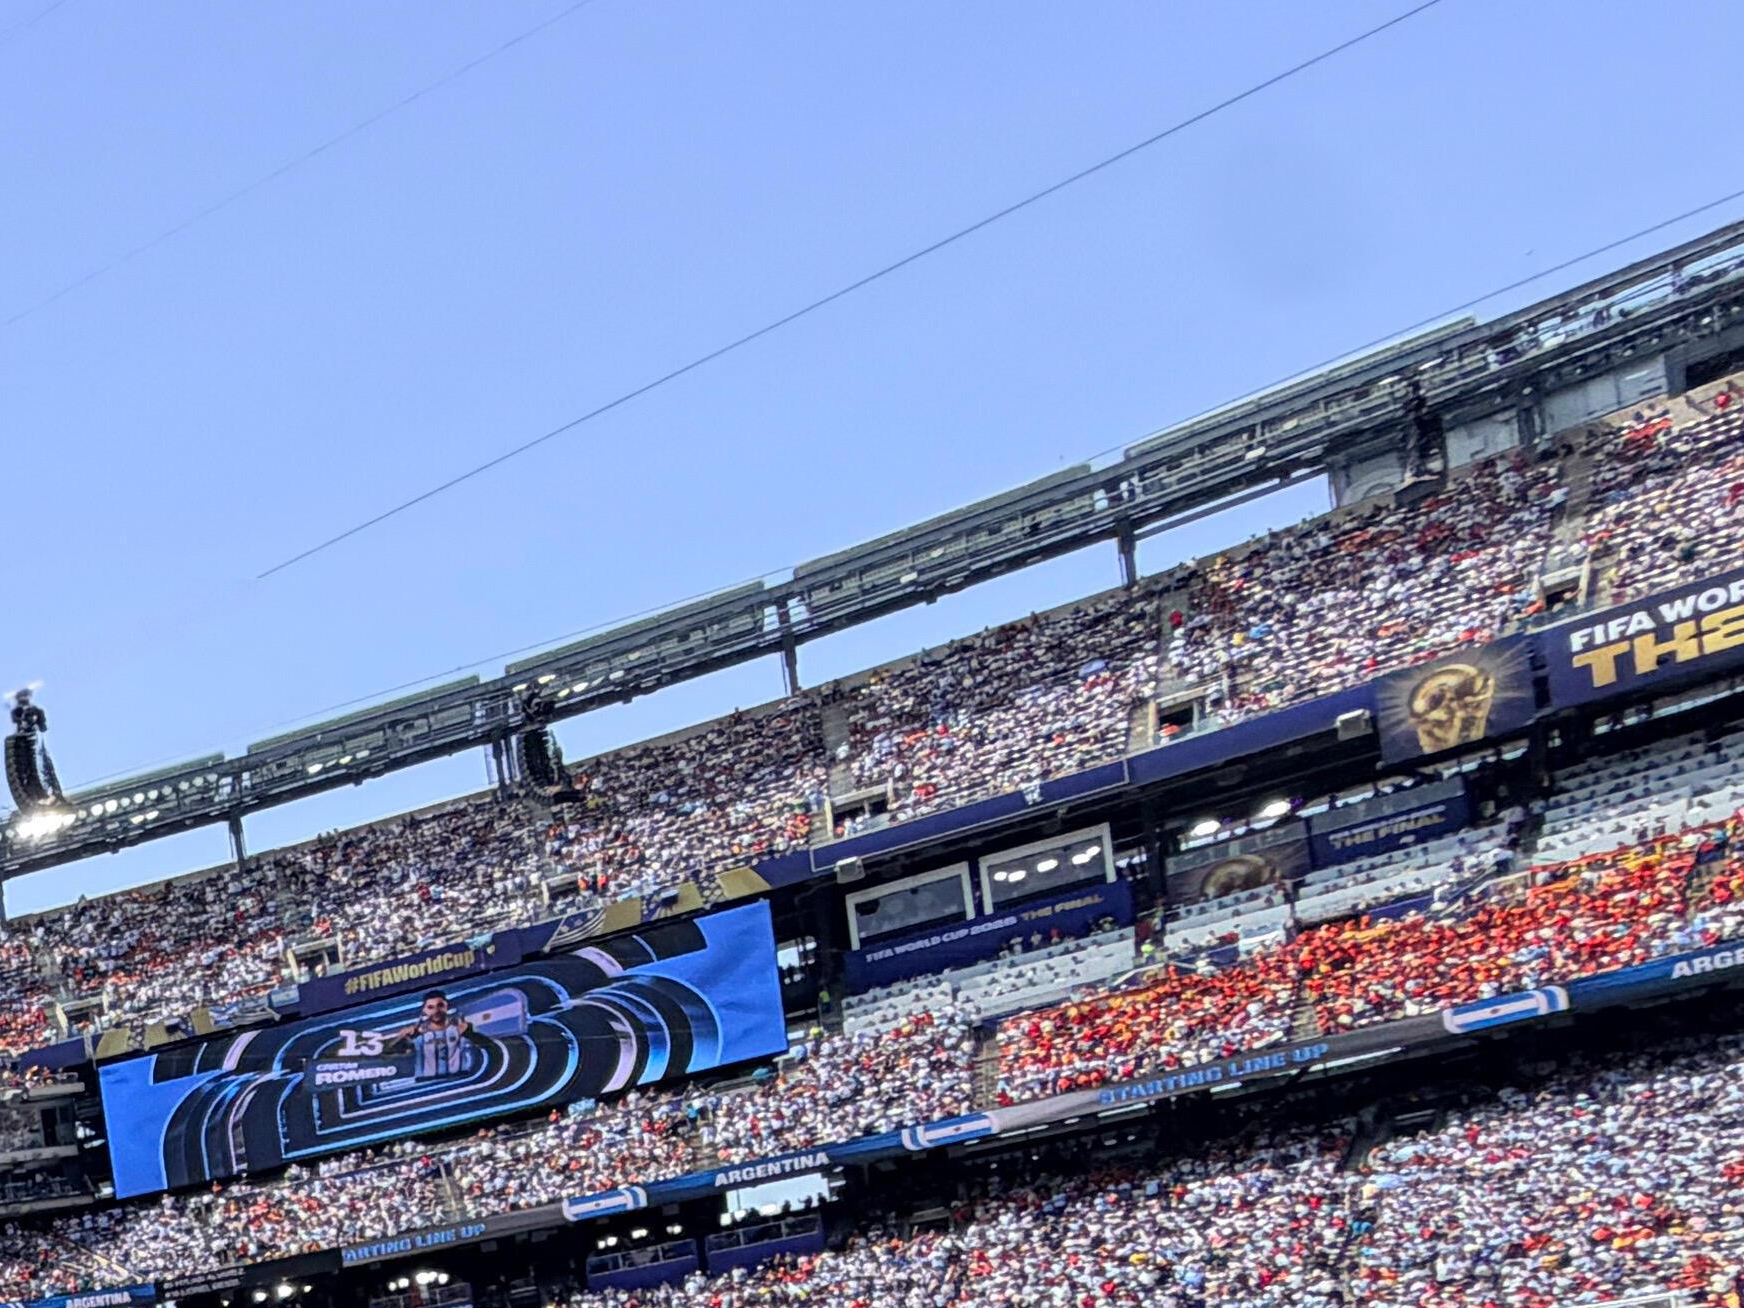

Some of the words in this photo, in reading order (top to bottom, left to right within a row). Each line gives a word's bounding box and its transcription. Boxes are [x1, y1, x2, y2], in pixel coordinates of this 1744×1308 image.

[1570, 611, 1656, 652] FIFA
[1573, 604, 1744, 688] THE
[942, 929, 969, 942] CUP
[344, 950, 475, 995] #FIFAWorldCup
[338, 1029, 384, 1057] 13
[315, 1066, 397, 1086] ROMERO
[1097, 1066, 1223, 1104] STARTING
[1228, 1052, 1286, 1077] LINE
[1293, 1043, 1328, 1063] UP
[715, 1152, 830, 1187] ARGENTINA
[415, 1229, 456, 1248] LINE
[461, 1223, 486, 1238] UP
